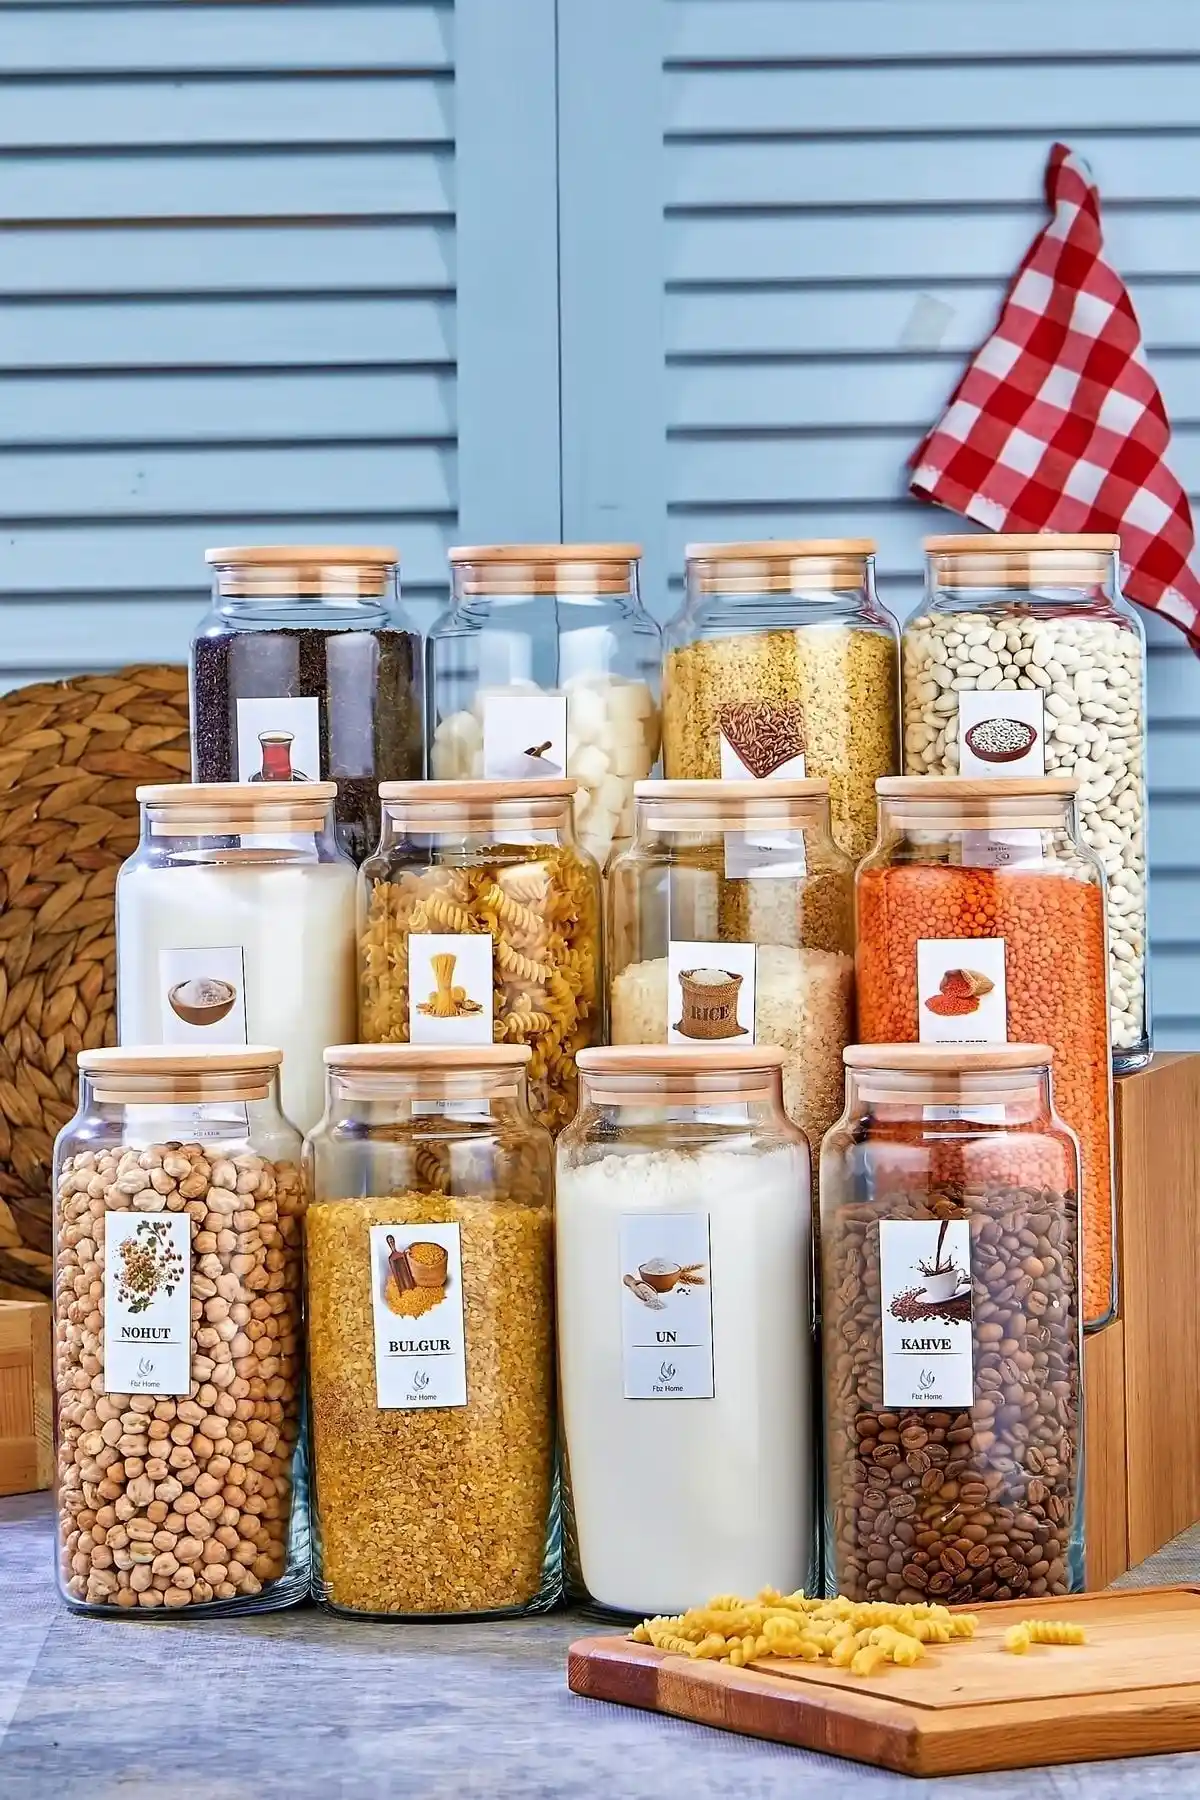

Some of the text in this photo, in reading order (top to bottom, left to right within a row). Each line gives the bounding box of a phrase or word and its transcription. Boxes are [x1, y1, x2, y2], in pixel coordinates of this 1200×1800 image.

[691, 1004, 730, 1021] RICE
[121, 1326, 171, 1339] NOHUT
[656, 1331, 677, 1343] UN
[389, 1339, 451, 1352] BULGUR
[901, 1338, 952, 1350] KAHVE
[142, 1380, 161, 1388] Home
